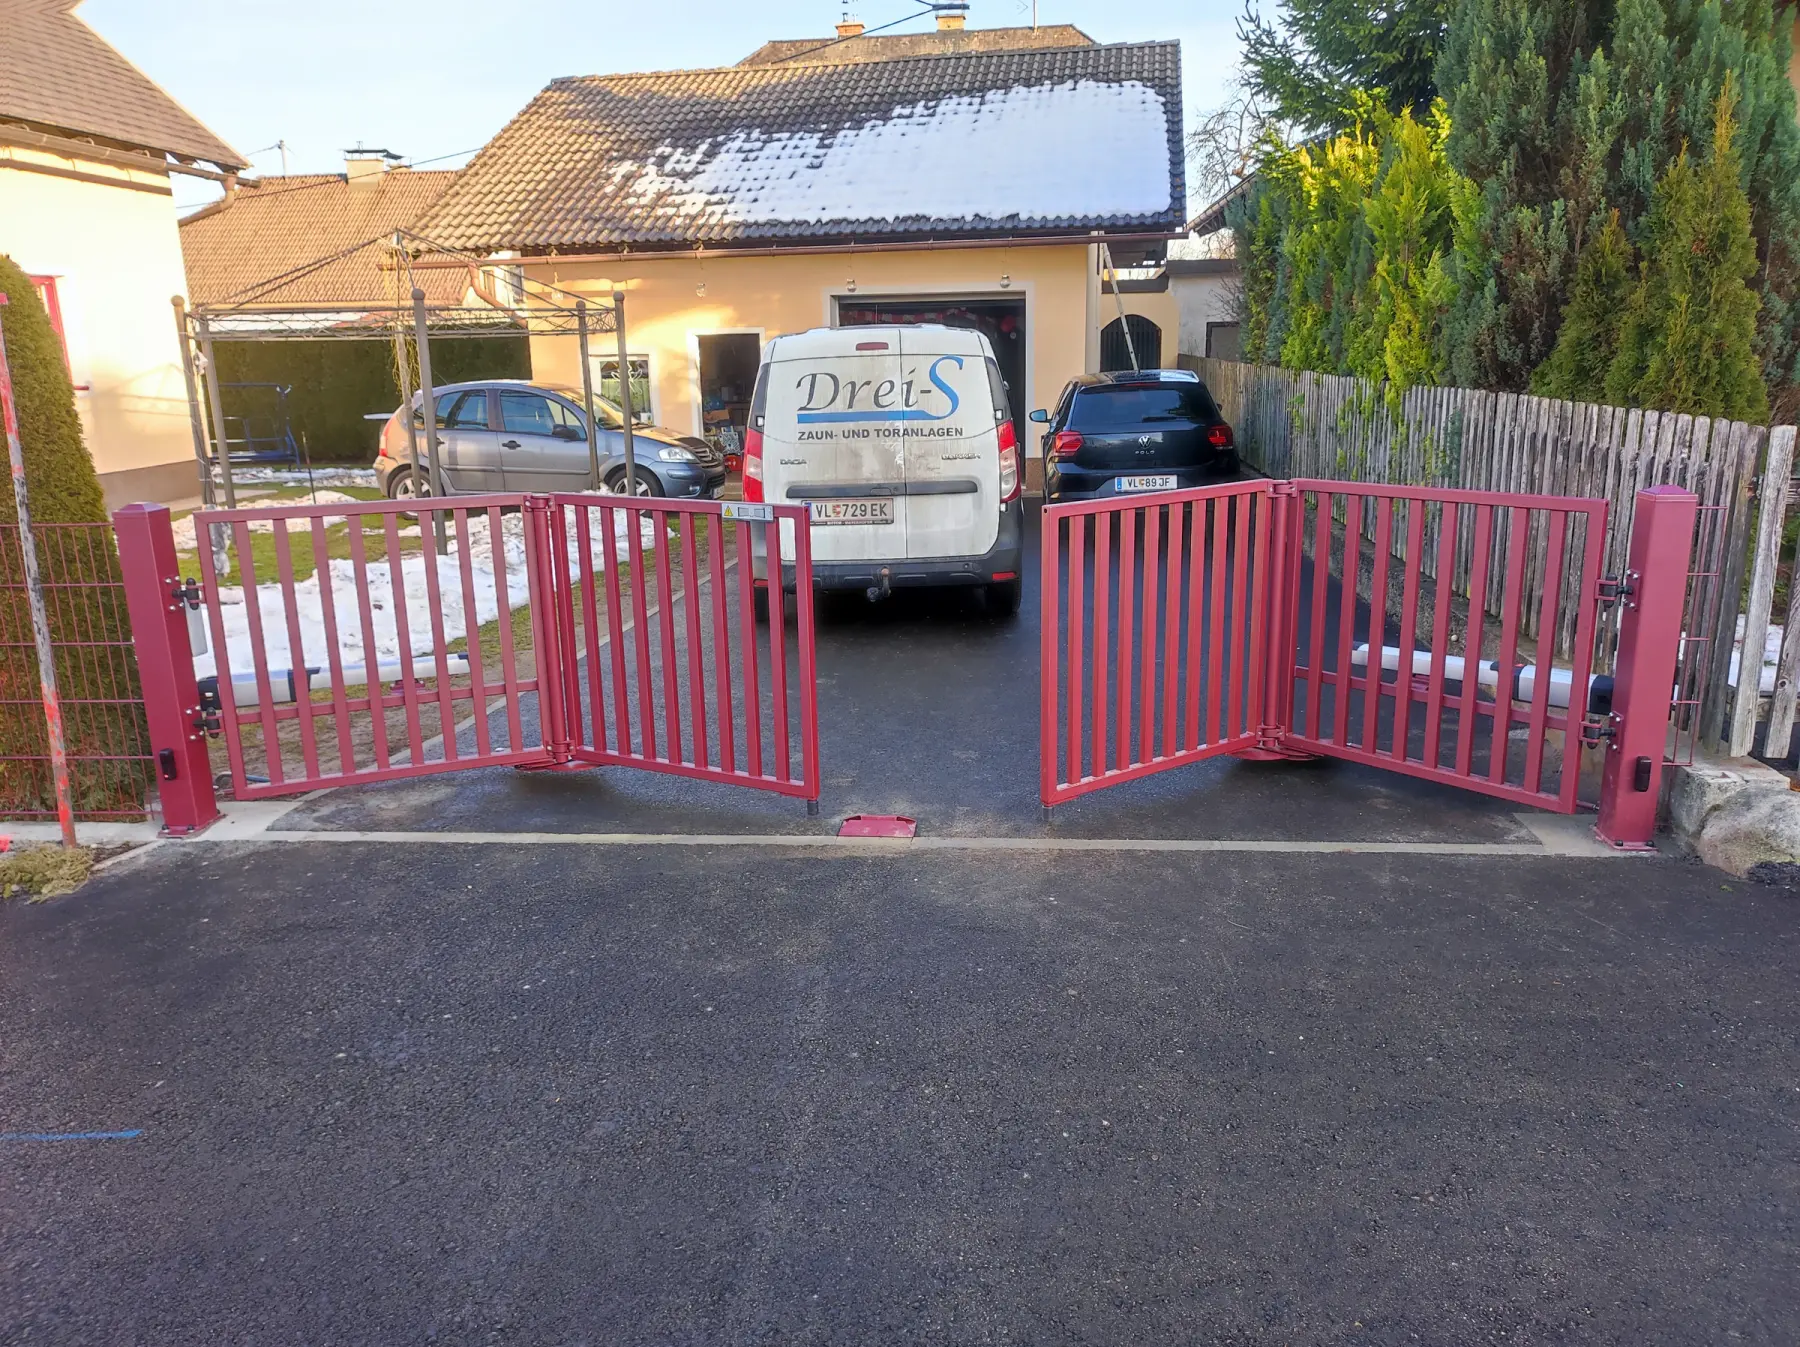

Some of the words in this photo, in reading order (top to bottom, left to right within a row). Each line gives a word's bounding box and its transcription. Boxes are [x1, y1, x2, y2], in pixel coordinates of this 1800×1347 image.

[796, 354, 964, 419] Drei-S
[798, 431, 838, 441] ZAUN-
[842, 429, 870, 440] UND
[874, 427, 964, 438] TORANLAGEN
[1127, 478, 1139, 488] VL
[1145, 477, 1157, 487] 89
[1158, 477, 1171, 487] JF
[815, 504, 832, 518] VL
[841, 503, 868, 517] 729
[870, 503, 887, 517] EK
